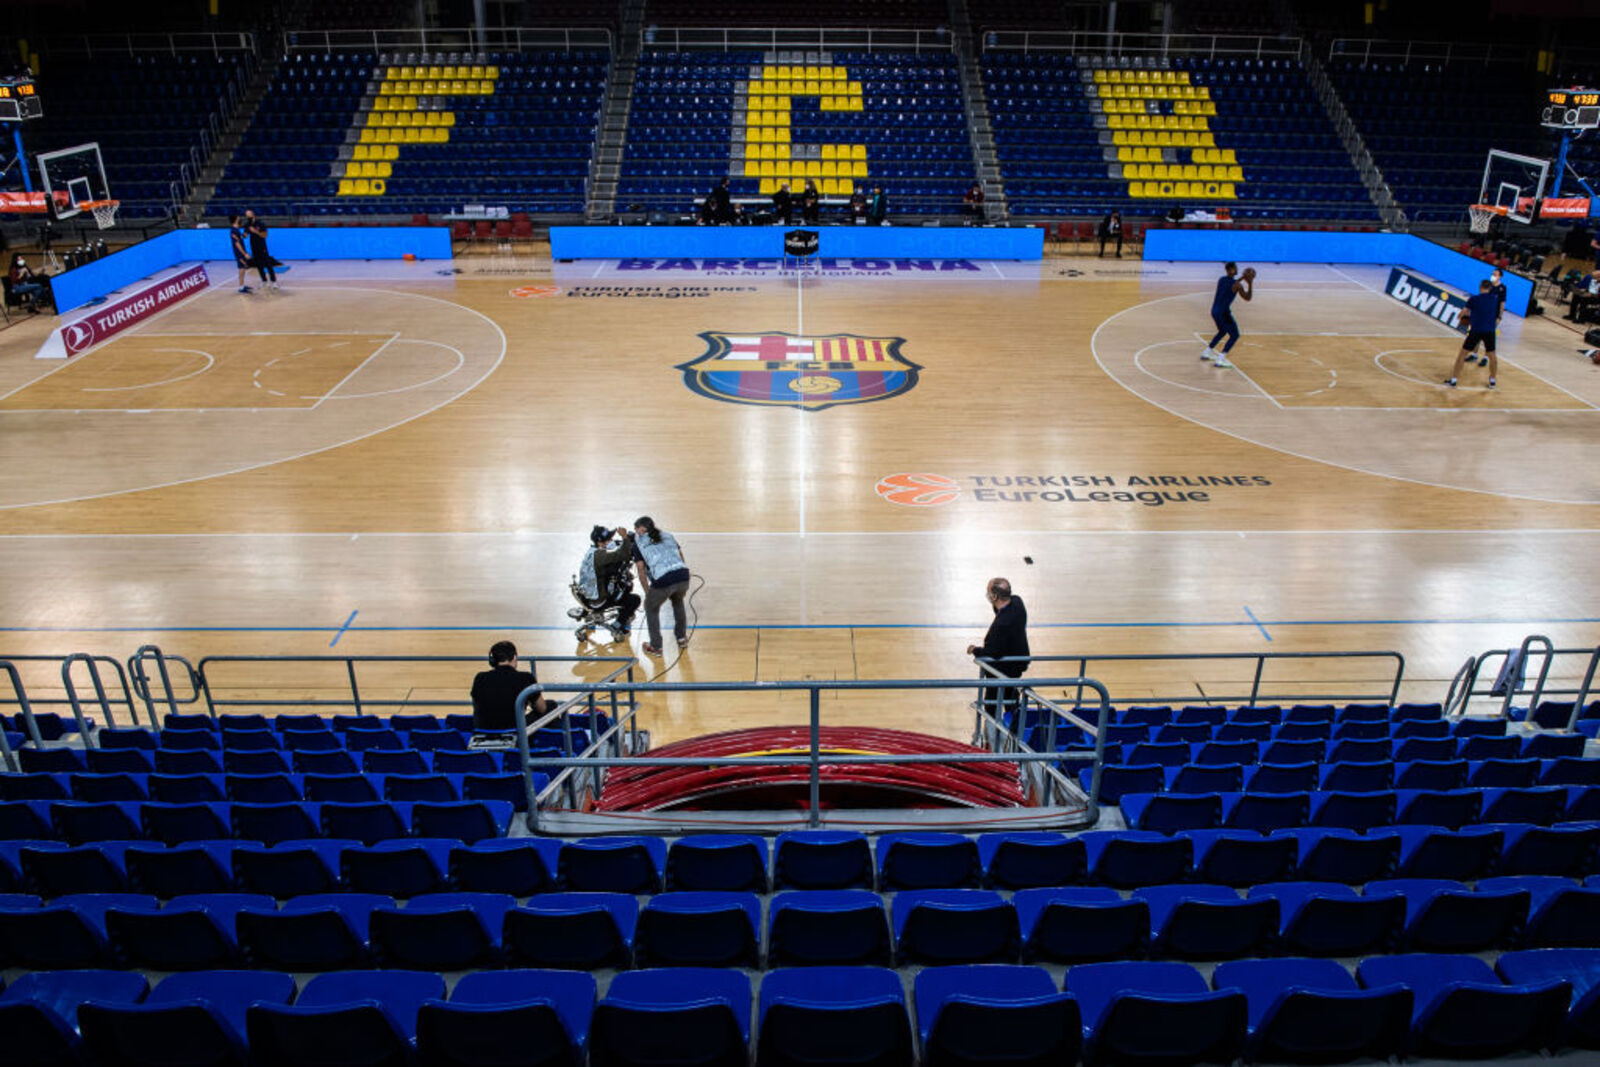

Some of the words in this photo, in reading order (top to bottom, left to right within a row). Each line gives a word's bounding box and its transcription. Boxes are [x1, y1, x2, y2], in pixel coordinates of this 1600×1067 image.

[97, 295, 156, 332] TURKISH
[157, 271, 207, 304] AIRLINES
[1391, 273, 1463, 329] bwin
[967, 474, 1115, 487] TURKISH
[1126, 474, 1273, 487] AIRLINES
[972, 488, 1211, 507] EuroLeague
